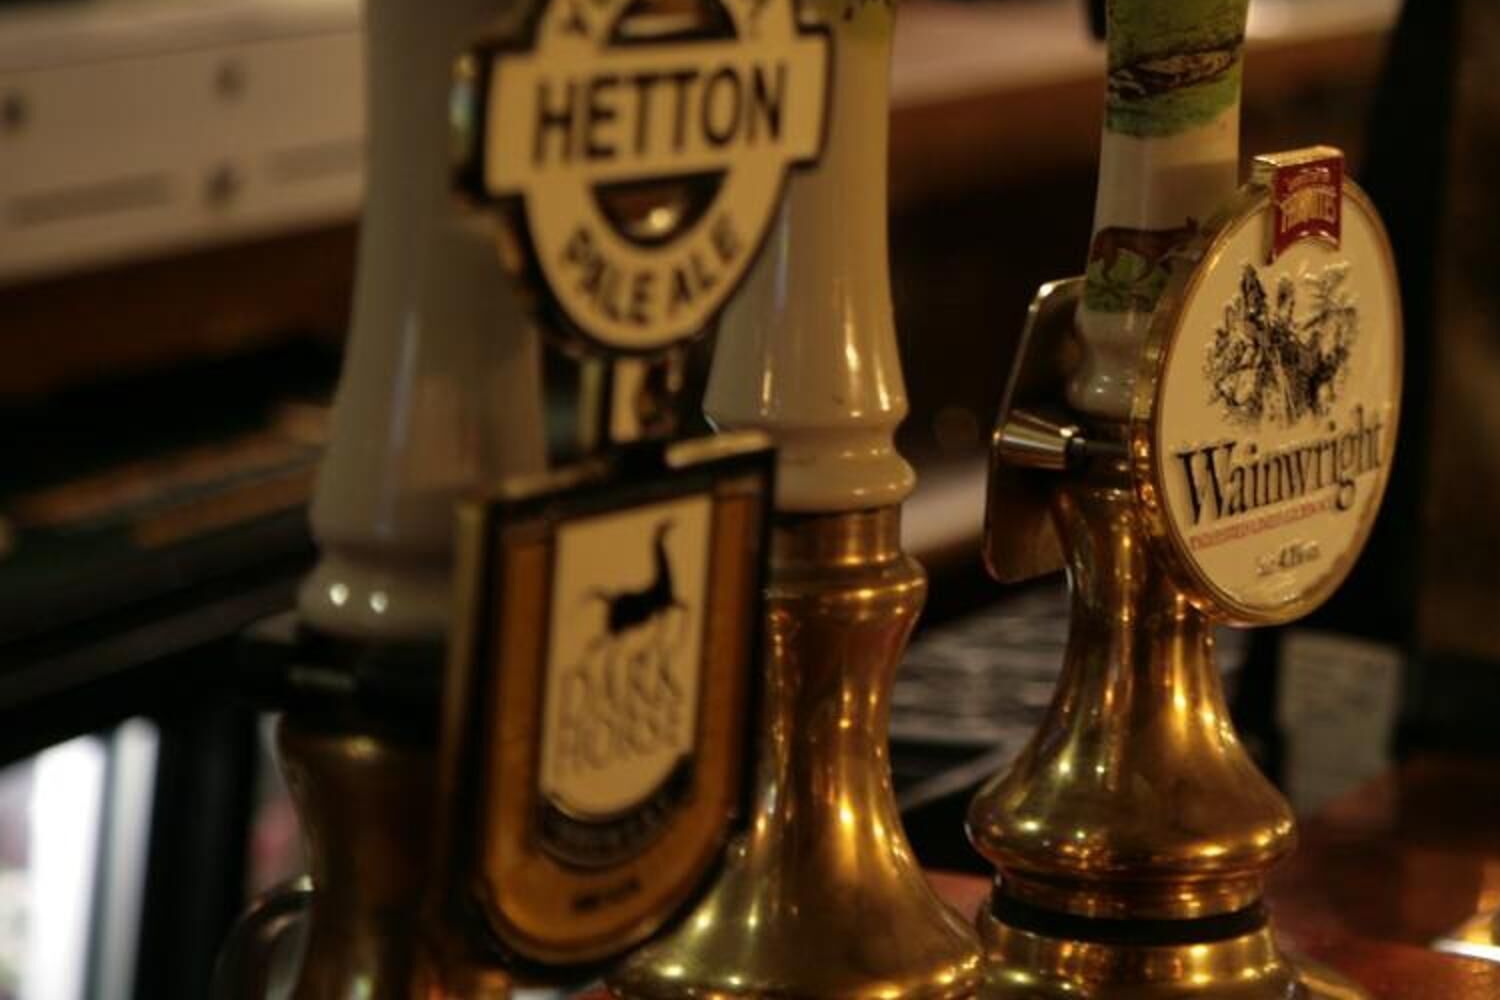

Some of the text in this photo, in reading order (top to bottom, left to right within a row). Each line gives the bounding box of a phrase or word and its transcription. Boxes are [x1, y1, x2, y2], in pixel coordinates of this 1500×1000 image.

[530, 63, 789, 169] HETTON
[558, 214, 740, 326] PALE ALE
[1175, 403, 1384, 525] Wainwright
